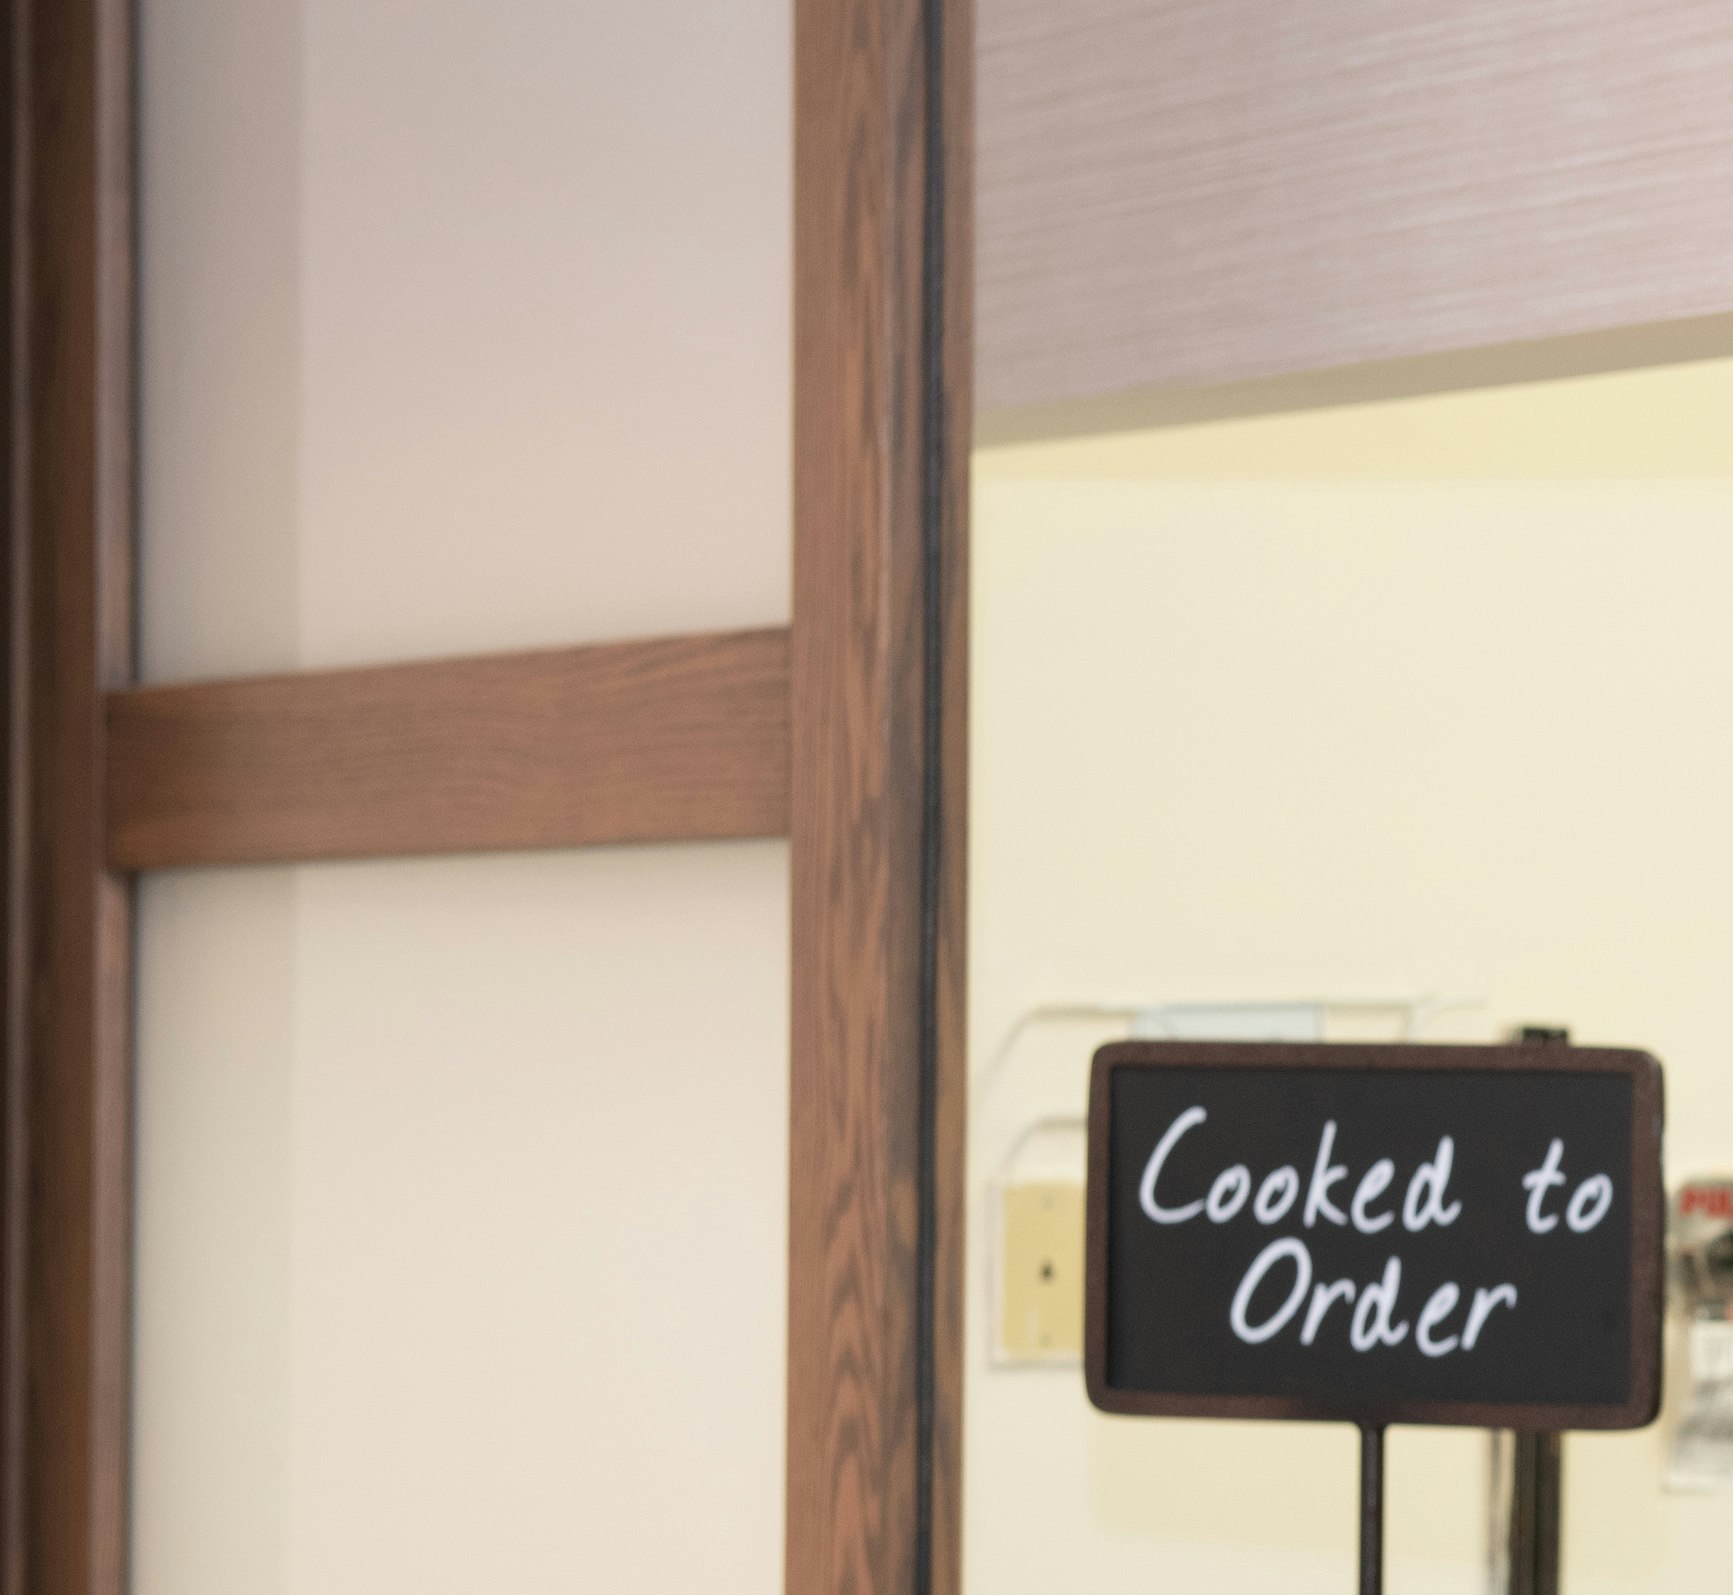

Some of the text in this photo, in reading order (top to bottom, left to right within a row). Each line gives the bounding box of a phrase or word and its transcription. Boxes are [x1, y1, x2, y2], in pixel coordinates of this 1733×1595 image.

[1139, 1105, 1614, 1234] Cooked to
[1230, 1236, 1518, 1358] Order
